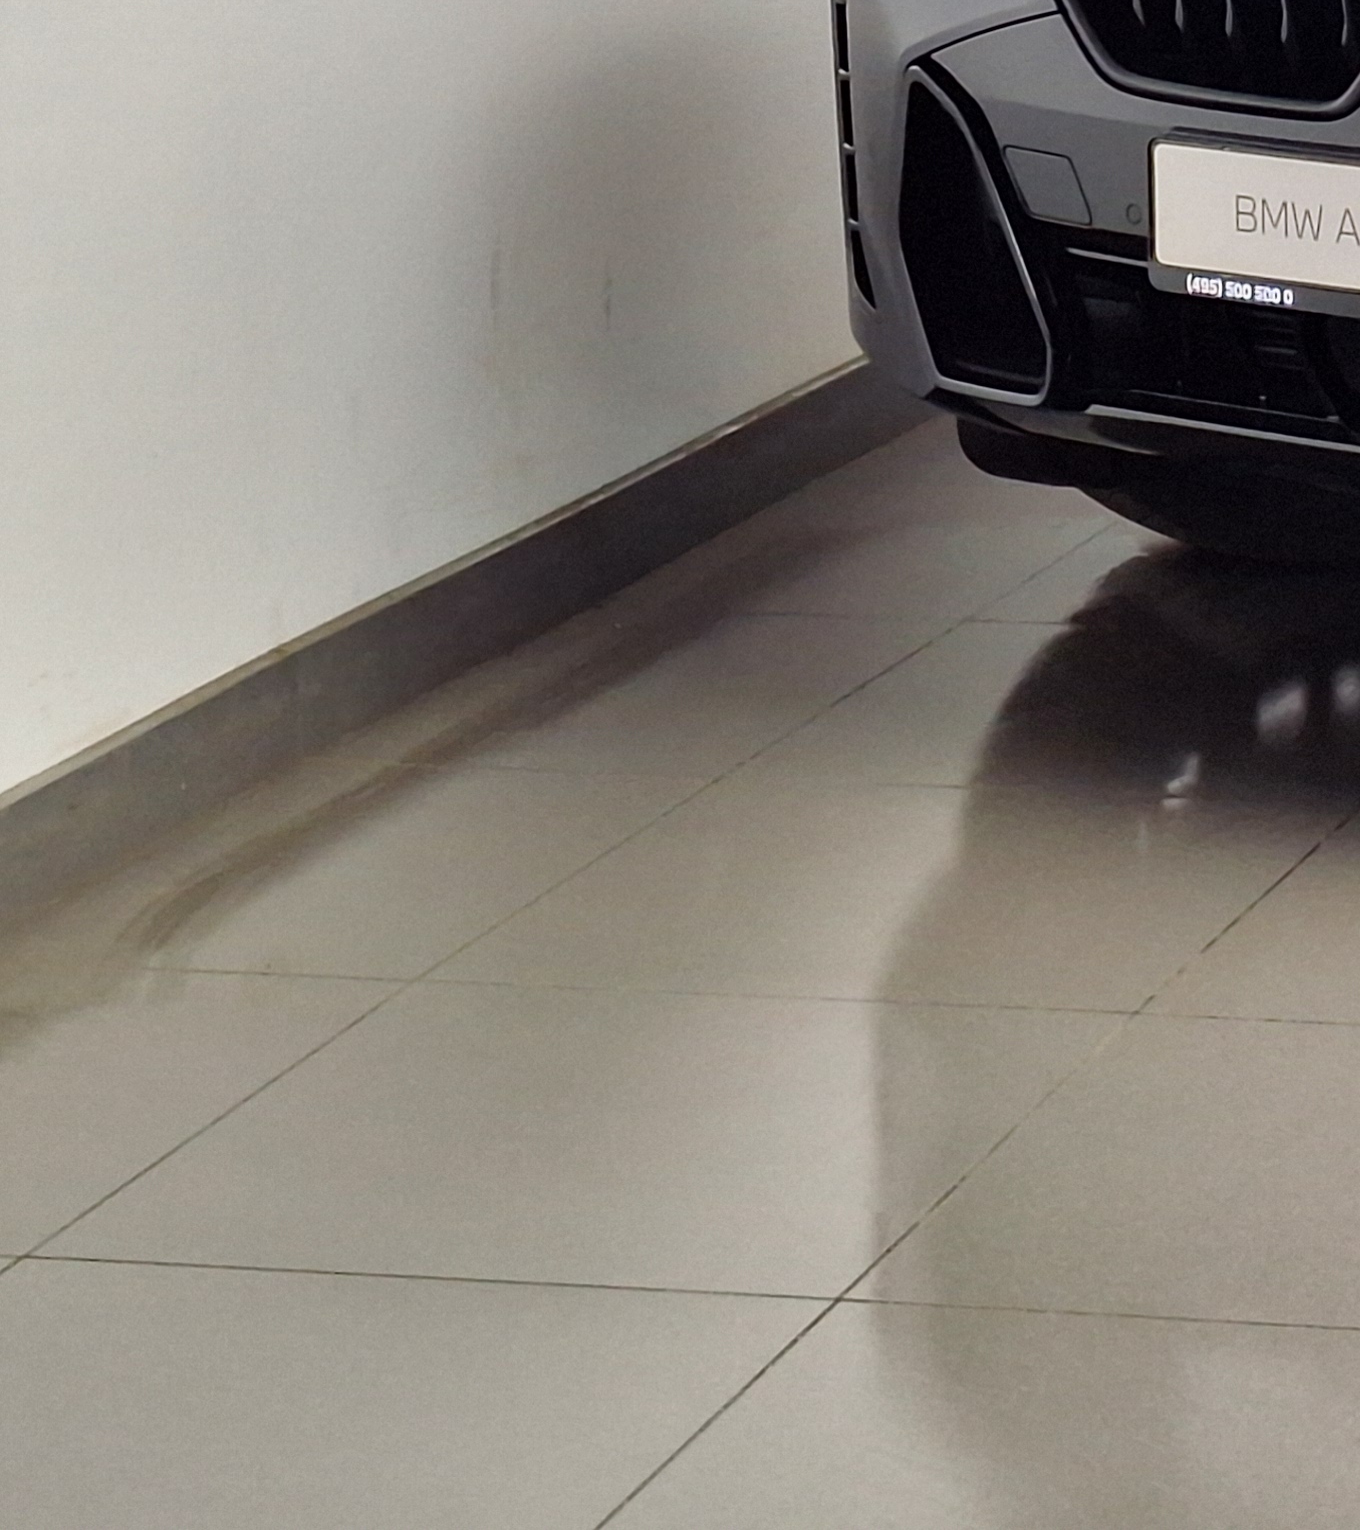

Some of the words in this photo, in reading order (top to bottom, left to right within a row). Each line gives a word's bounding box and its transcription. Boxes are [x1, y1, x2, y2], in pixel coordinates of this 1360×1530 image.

[1235, 194, 1323, 242] BMW
[1186, 273, 1223, 299] (495)
[1225, 281, 1252, 300] 500
[1254, 285, 1281, 304] 500
[1283, 288, 1294, 305] 0
